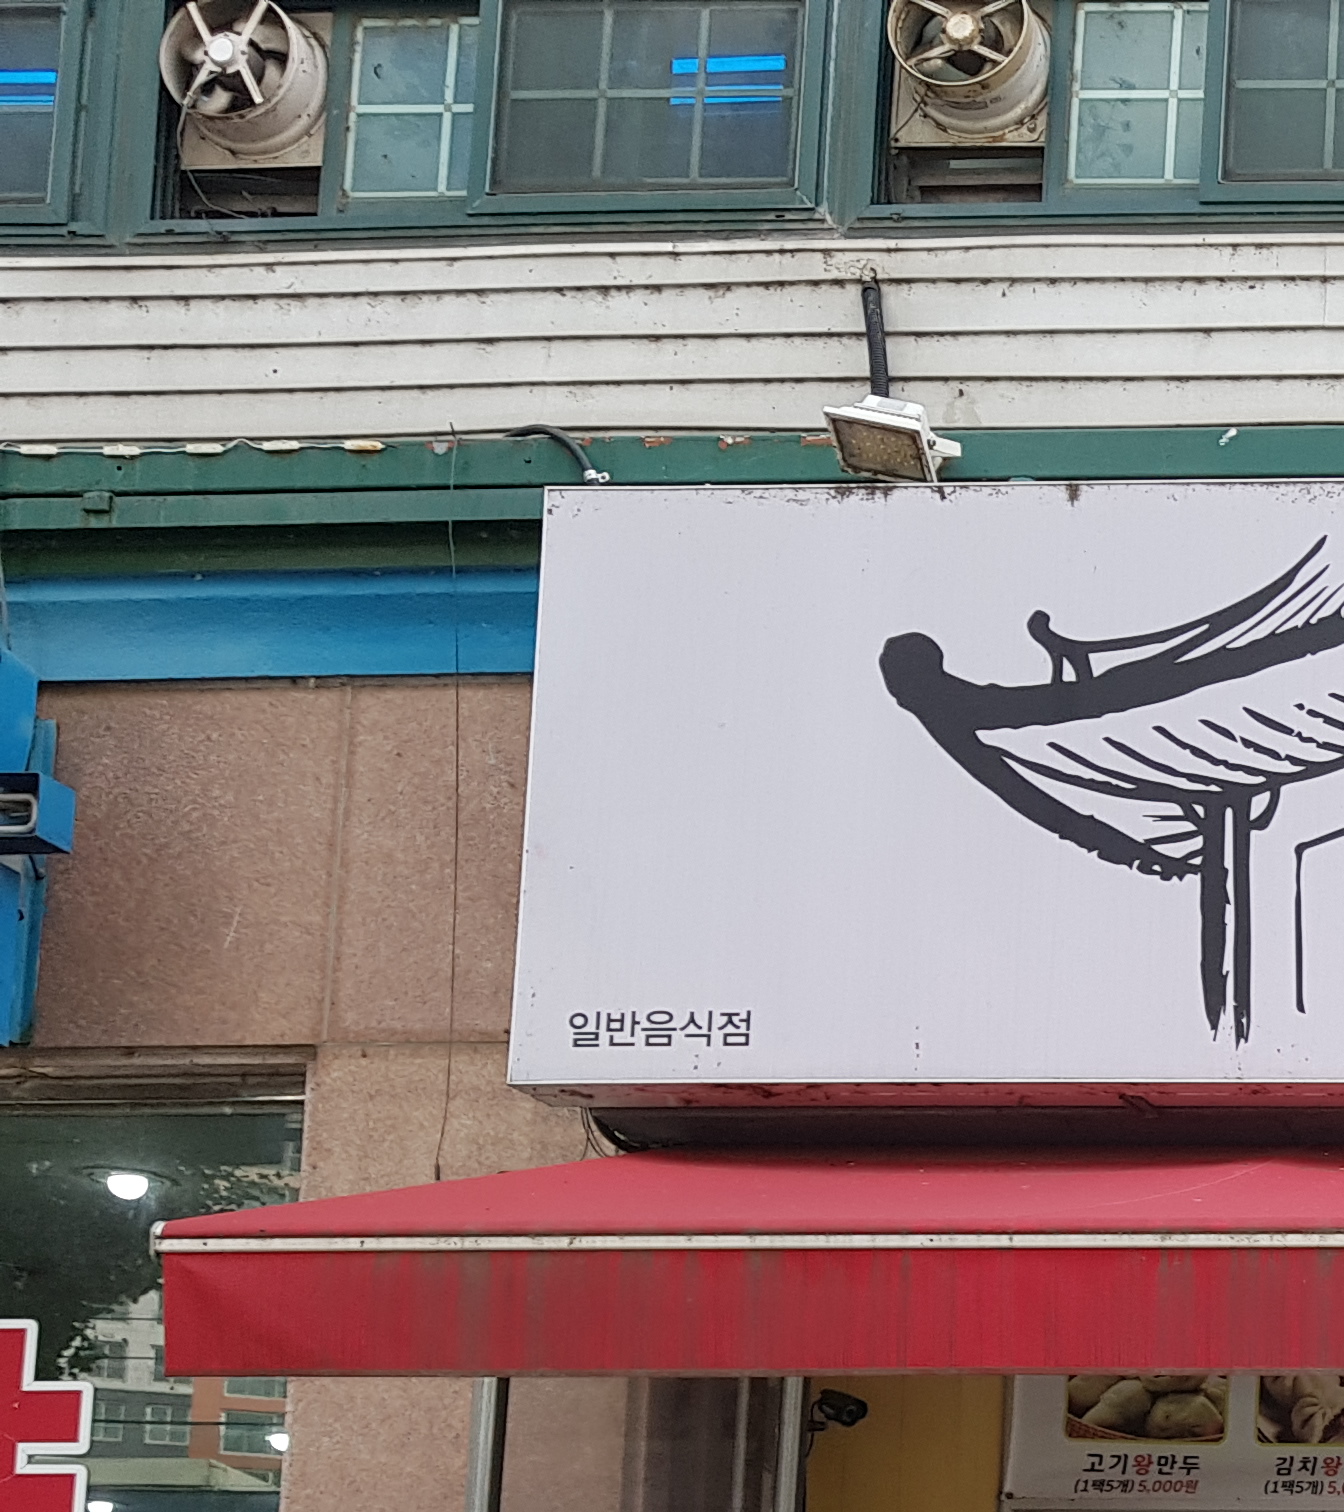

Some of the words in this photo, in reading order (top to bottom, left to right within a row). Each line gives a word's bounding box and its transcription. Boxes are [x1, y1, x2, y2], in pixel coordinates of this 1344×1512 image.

[569, 1010, 751, 1047] 일반음식점
[1082, 1454, 1200, 1480] 고기왕만두
[1074, 1479, 1134, 1493] (1팩5개)
[1137, 1480, 1199, 1494] 5,000원
[1264, 1480, 1324, 1495] (1팩5개)
